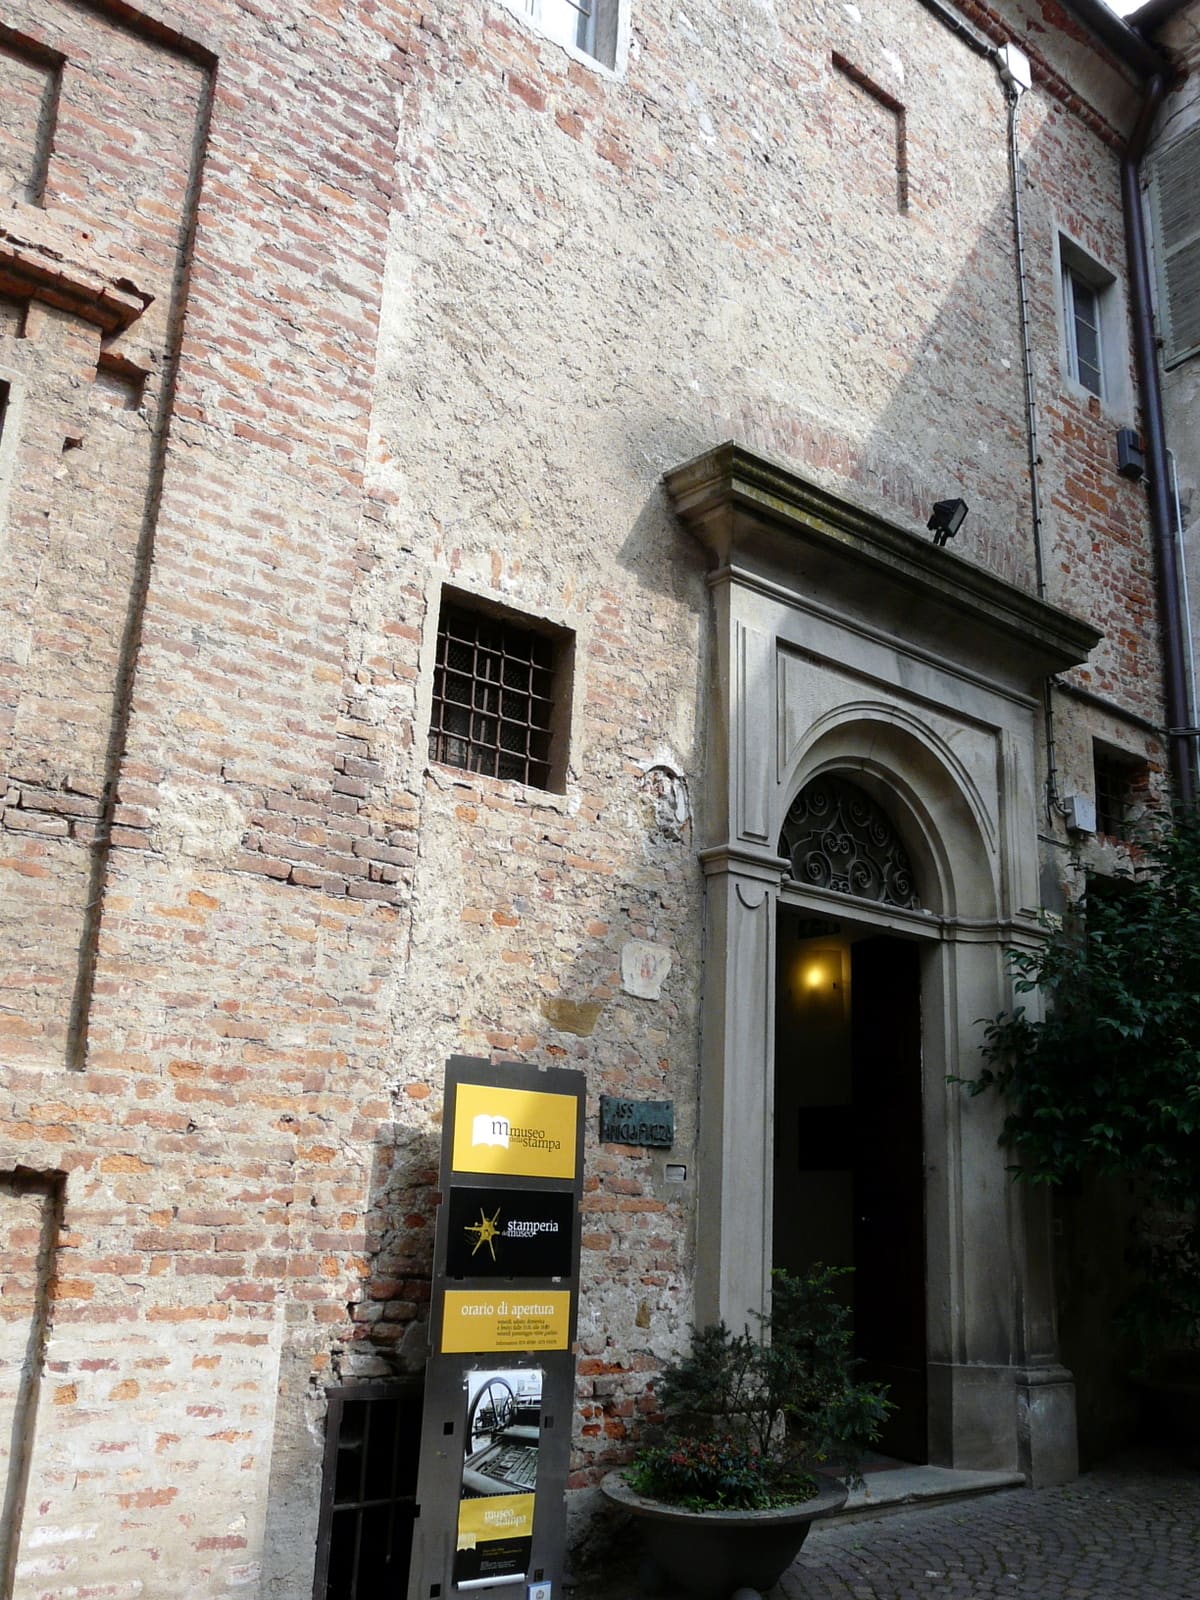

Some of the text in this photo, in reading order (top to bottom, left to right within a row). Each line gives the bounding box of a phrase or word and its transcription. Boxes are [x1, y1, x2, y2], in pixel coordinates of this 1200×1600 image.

[510, 1127, 545, 1139] museo
[522, 1137, 561, 1152] stampa
[507, 1220, 559, 1233] stamperia
[461, 1301, 554, 1319] orario di apertura
